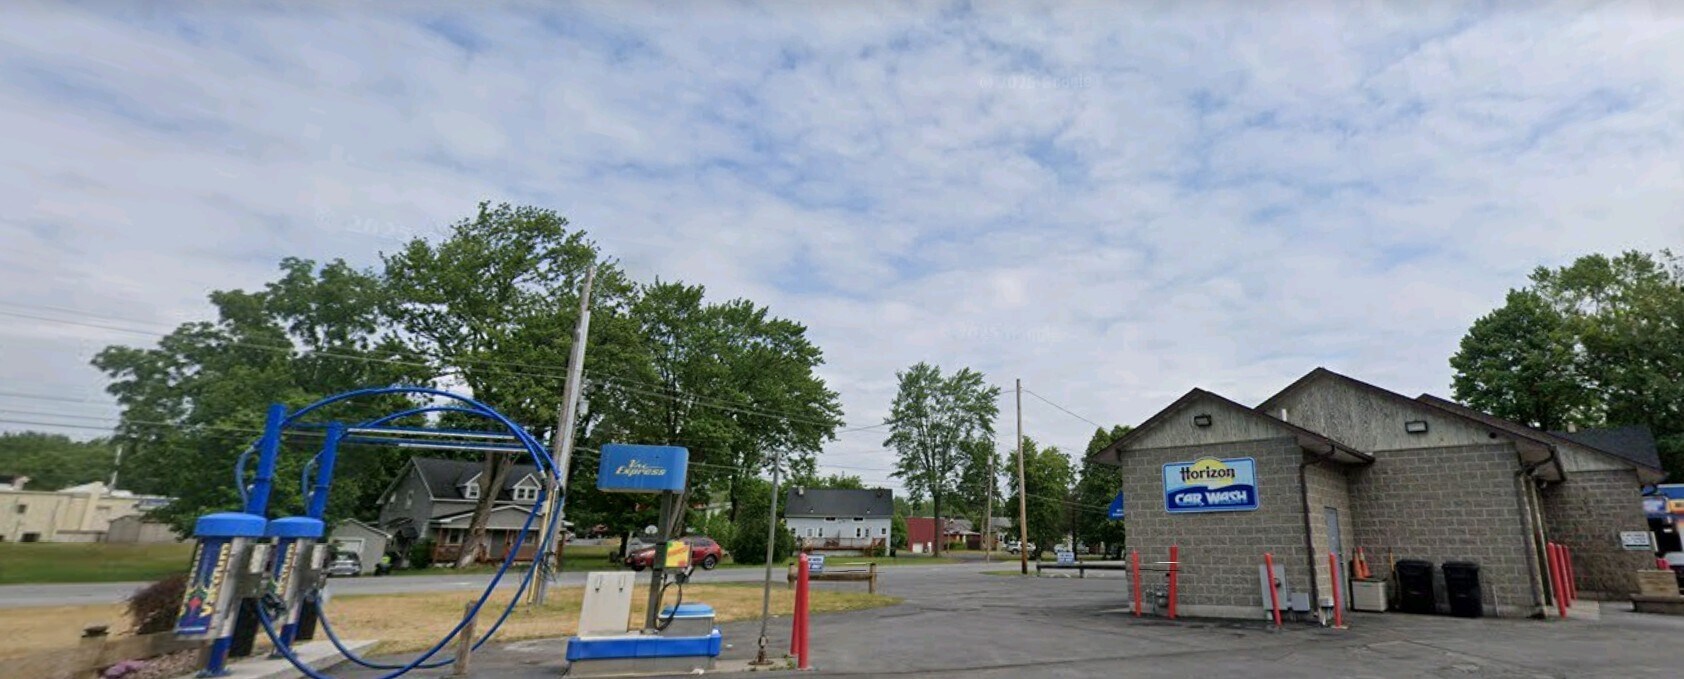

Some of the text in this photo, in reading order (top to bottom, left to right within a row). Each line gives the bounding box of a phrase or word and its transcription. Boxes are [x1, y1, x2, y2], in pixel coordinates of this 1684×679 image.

[615, 465, 667, 478] Express
[1179, 465, 1236, 482] Horizon
[1174, 489, 1248, 507] CAR WASH
